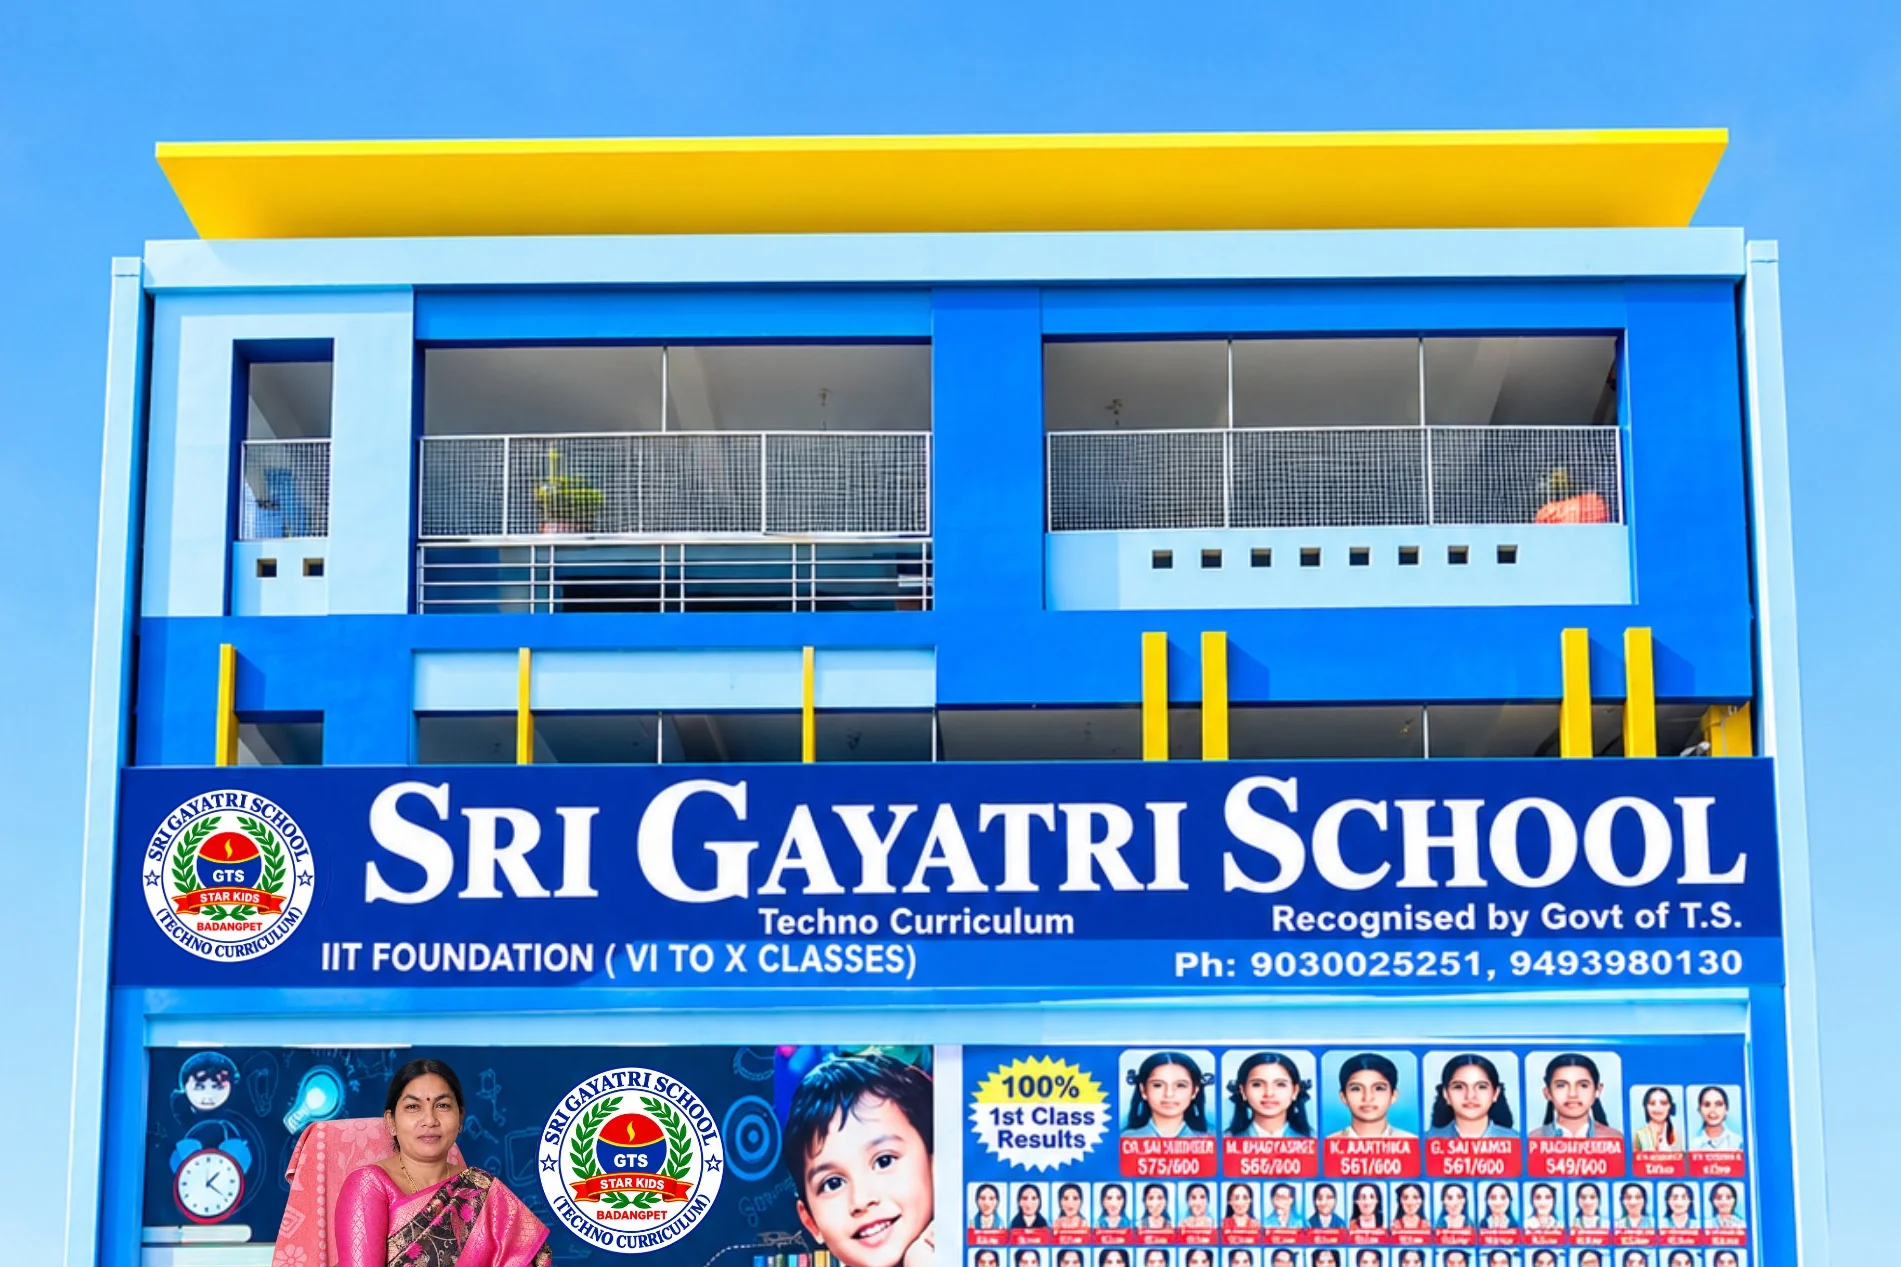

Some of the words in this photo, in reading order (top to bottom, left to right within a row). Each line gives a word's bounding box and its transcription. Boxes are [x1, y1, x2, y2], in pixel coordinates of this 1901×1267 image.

[148, 829, 172, 862] SRI
[168, 793, 248, 830] GAYATRI
[250, 798, 309, 862] SCHOOL
[366, 782, 599, 903] SRI
[638, 780, 1188, 902] GAYATRI
[1224, 777, 1746, 892] SCHOOL
[212, 870, 245, 882] GTS
[200, 892, 230, 902] STAR
[233, 892, 260, 902] KIDS
[197, 922, 262, 931] BADANGPET
[759, 908, 877, 934] Techno
[891, 908, 1073, 934] Curriculum
[1274, 904, 1474, 938] Recognised
[1489, 904, 1528, 936] by
[1542, 903, 1622, 929] Govt
[1636, 902, 1669, 928] of
[1681, 902, 1741, 927] T.S.
[156, 907, 212, 955] (TECHNO
[215, 907, 303, 958] CURRICULUM)
[323, 943, 361, 970] IIT
[374, 943, 592, 971] FOUNDATION
[627, 944, 656, 971] VI
[669, 945, 713, 971] TO
[726, 945, 746, 971] X
[759, 944, 915, 979] CLASSES)
[1176, 952, 1234, 976] Ph:
[1252, 952, 1495, 980] 9030025251,
[1511, 951, 1741, 975] 9493980130
[1001, 1075, 1080, 1098] 100%
[545, 1112, 570, 1145] SRI
[566, 1072, 652, 1113] GAYATRI
[654, 1077, 718, 1146] SCHOOL
[988, 1106, 1024, 1125] 1st
[1031, 1105, 1096, 1126] Class
[997, 1128, 1086, 1150] Results
[614, 1154, 648, 1167] GTS
[600, 1178, 632, 1189] STAR
[635, 1178, 664, 1189] KIDS
[553, 1195, 613, 1246] (TECHNO
[616, 1194, 710, 1248] CURRICULUM)
[597, 1210, 667, 1220] BADANGPET
